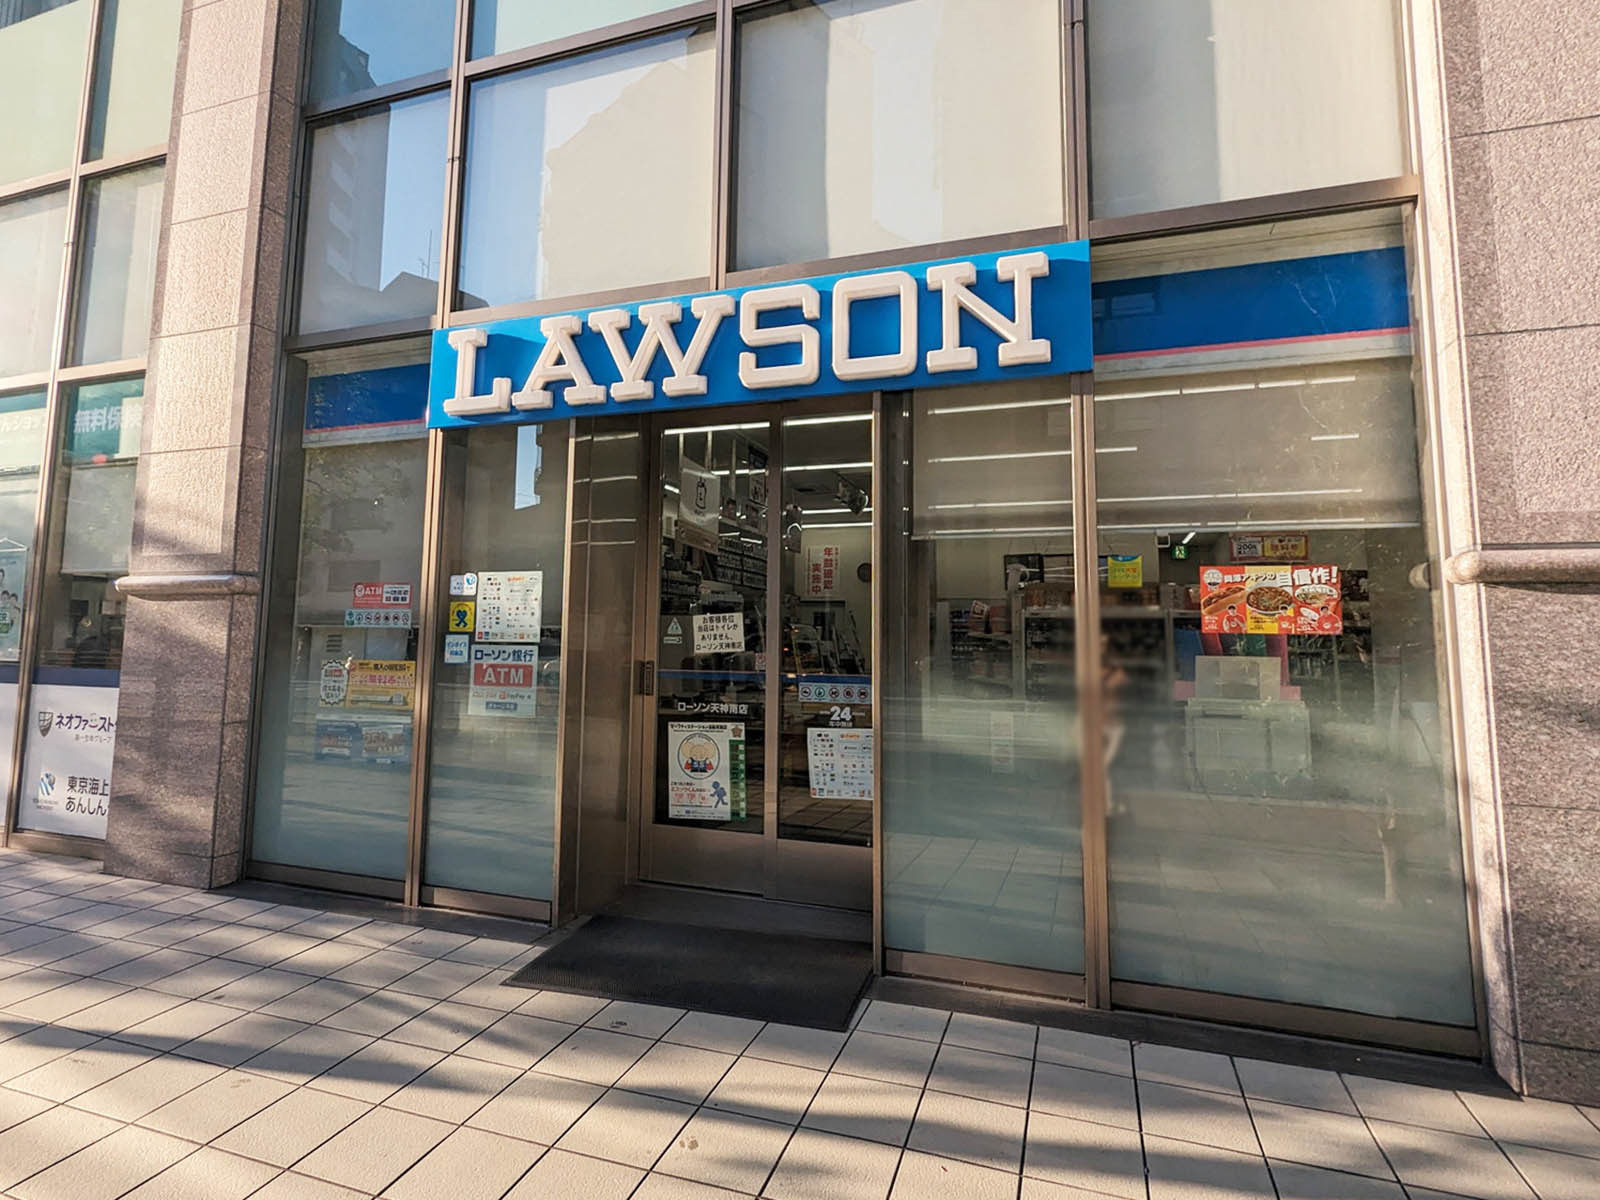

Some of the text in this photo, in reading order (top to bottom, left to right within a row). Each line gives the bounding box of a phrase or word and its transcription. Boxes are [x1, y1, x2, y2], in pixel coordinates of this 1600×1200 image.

[443, 250, 1051, 417] LAWSON
[365, 586, 382, 595] ATM
[474, 649, 534, 662] ローソン銀行
[483, 667, 523, 685] ATM
[830, 705, 852, 721] 24
[67, 776, 109, 796] 東京海上
[65, 797, 109, 816] あんしん
